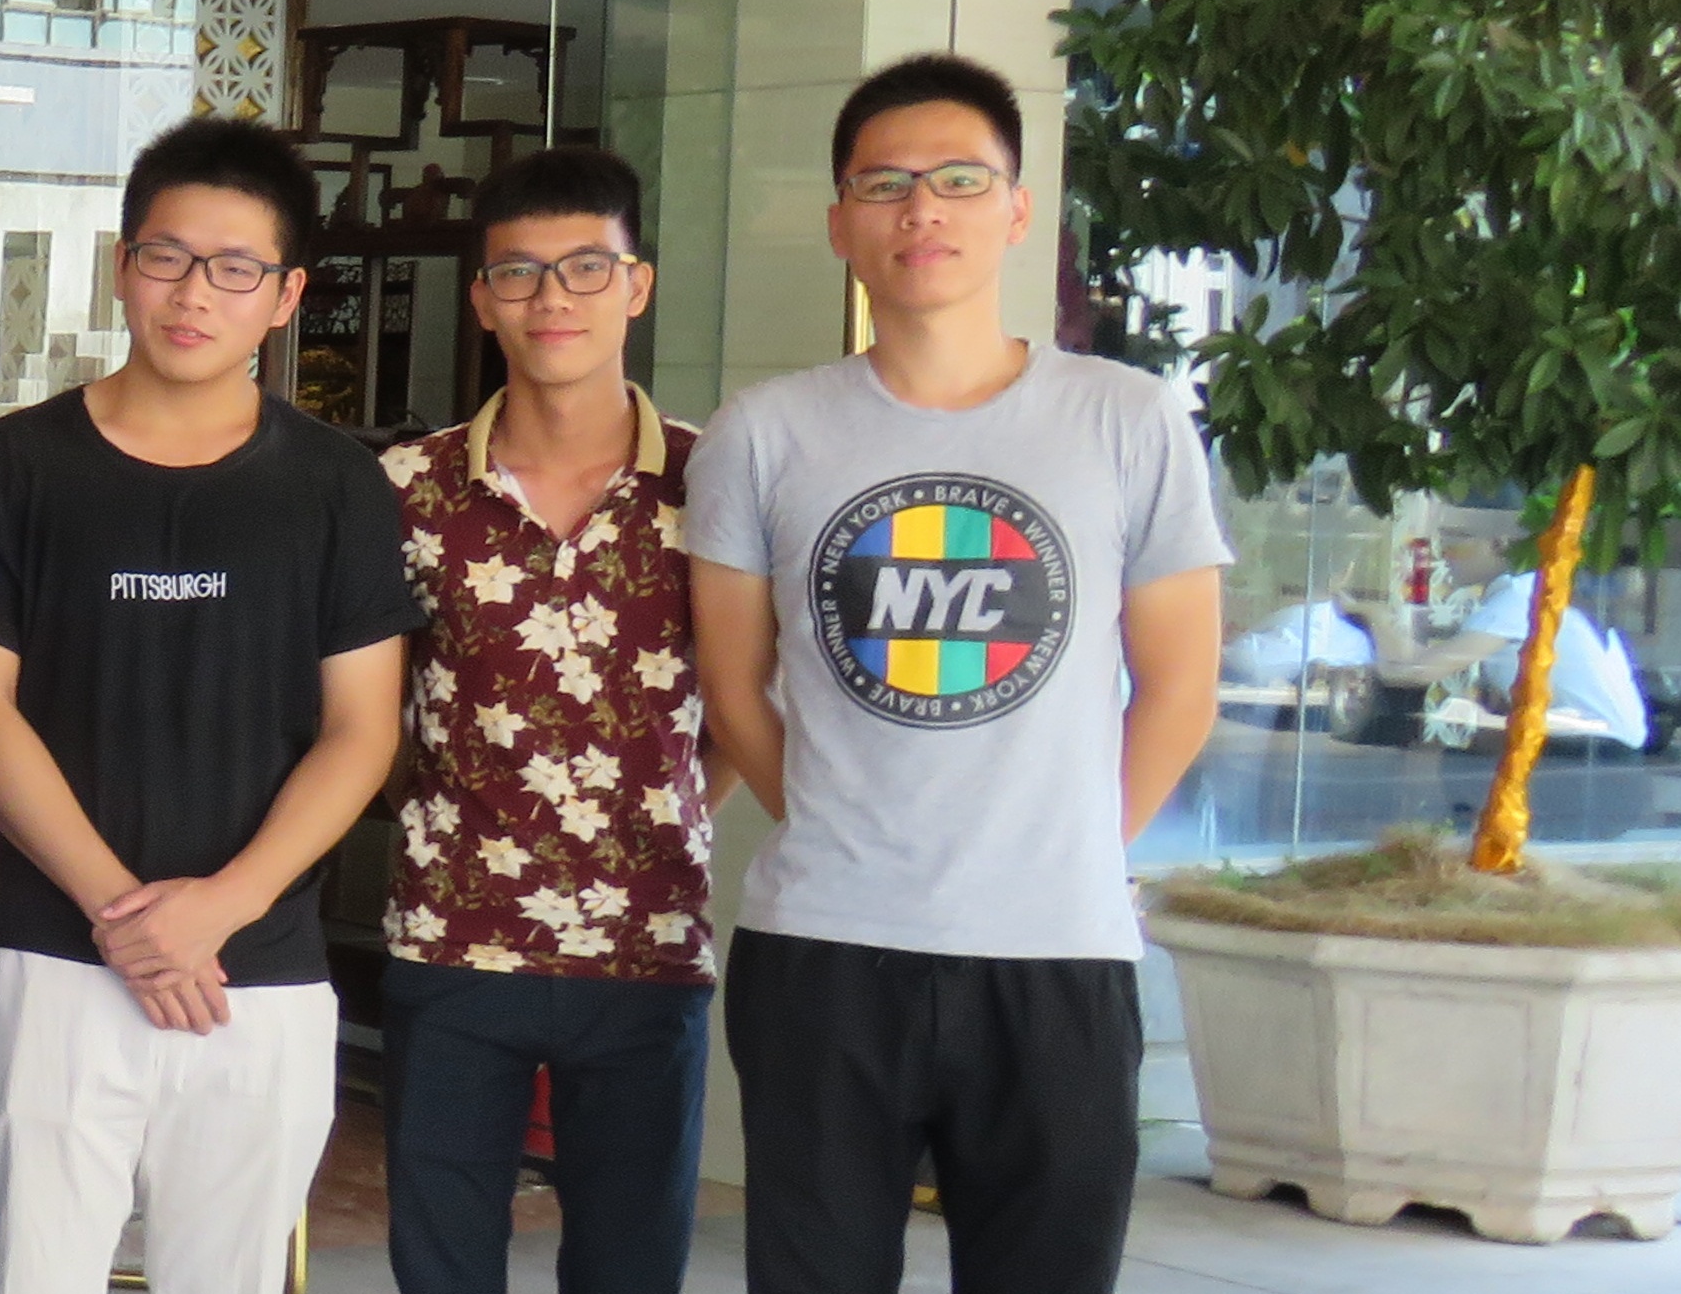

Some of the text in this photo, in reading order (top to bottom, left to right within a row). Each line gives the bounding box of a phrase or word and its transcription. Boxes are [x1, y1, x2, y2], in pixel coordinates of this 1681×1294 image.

[110, 572, 227, 600] PITTSBURGH
[820, 485, 1066, 718] NEW YORK BRAVE WINNER NEW YORK BRAVE WINNER
[866, 566, 1013, 633] NYC
